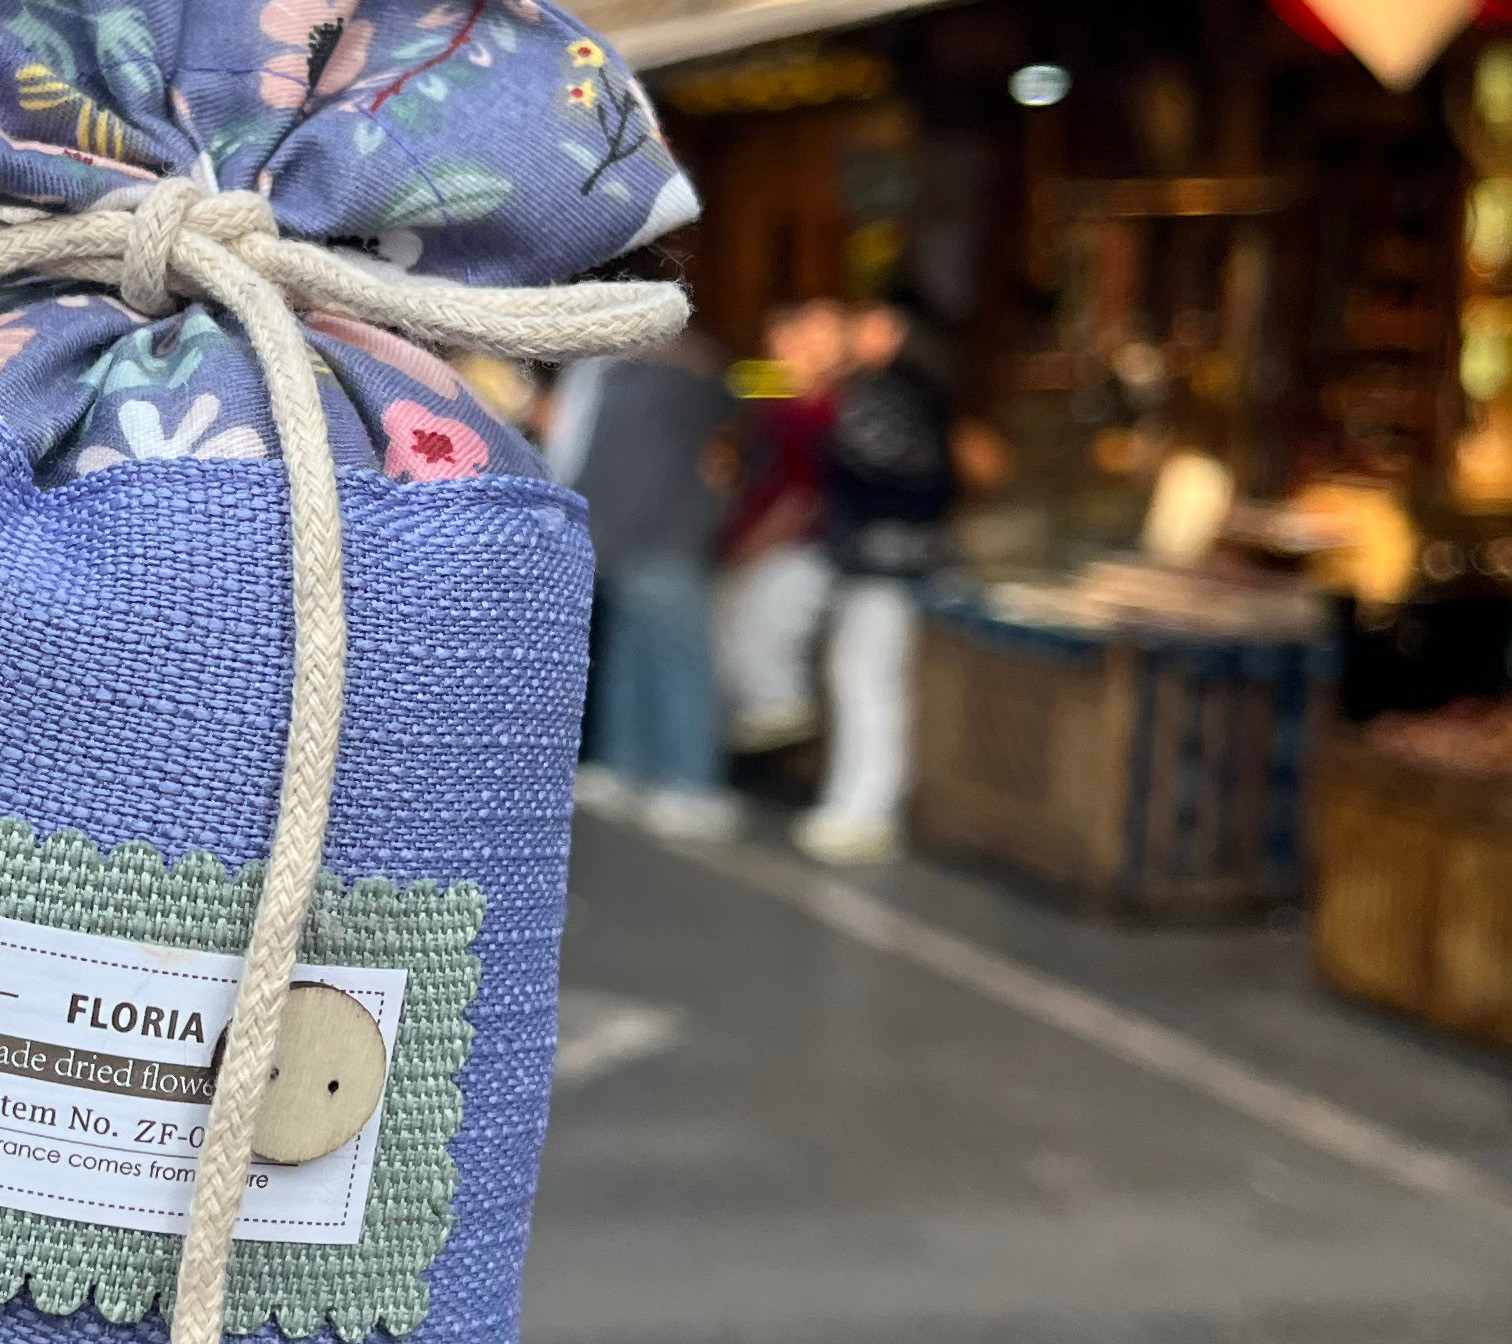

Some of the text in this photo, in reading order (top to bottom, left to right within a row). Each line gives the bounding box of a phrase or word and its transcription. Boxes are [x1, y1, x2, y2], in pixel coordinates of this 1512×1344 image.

[66, 992, 205, 1044] FLORIA
[54, 1049, 134, 1088] dried
[68, 1105, 119, 1138] No.
[68, 1152, 142, 1178] comes
[148, 1160, 196, 1184] from
